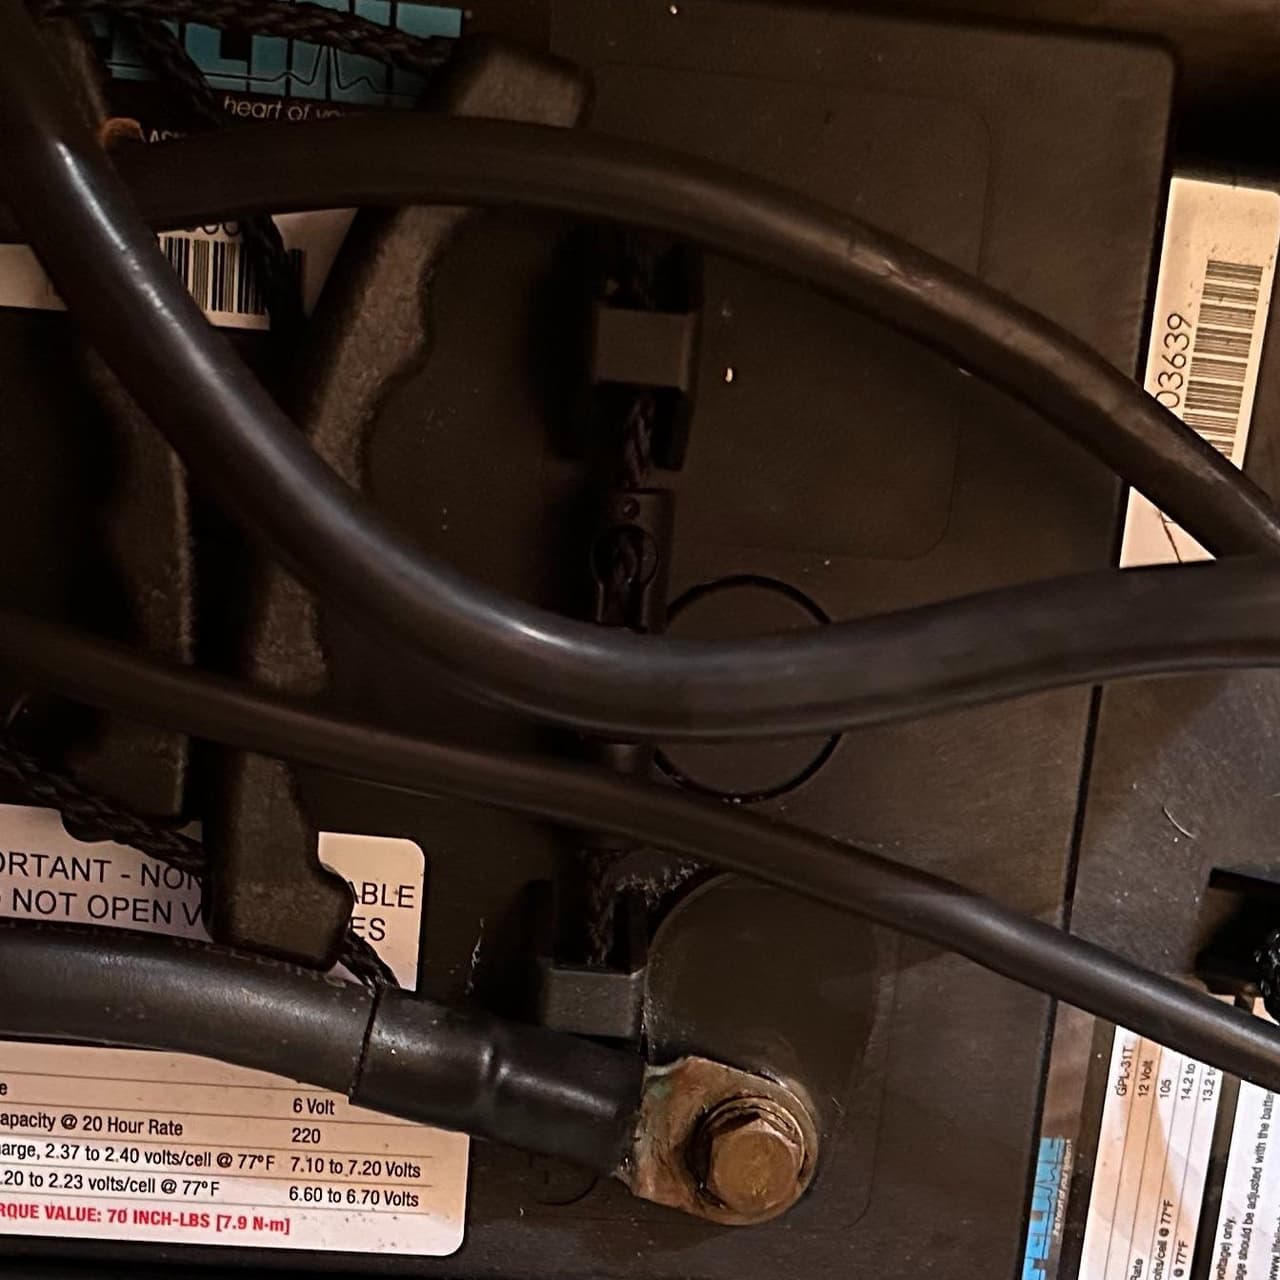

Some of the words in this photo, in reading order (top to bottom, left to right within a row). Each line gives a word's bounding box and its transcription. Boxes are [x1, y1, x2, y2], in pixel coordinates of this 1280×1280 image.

[224, 96, 283, 120] heart
[286, 101, 310, 120] of
[13, 887, 76, 916] NOT
[86, 893, 172, 925] OPEN
[1139, 1058, 1153, 1081] Volt
[1184, 1062, 1195, 1075] to
[1137, 1084, 1149, 1097] 12
[1158, 1078, 1171, 1099] 105
[1180, 1077, 1193, 1100] 14.2
[1201, 1078, 1214, 1102] 13.2
[292, 1098, 302, 1113] 6
[306, 1098, 335, 1115] Volt
[60, 1113, 77, 1130] @
[82, 1114, 102, 1131] 20
[107, 1116, 144, 1134] Hour
[148, 1118, 183, 1136] Rate
[291, 1128, 321, 1143] 220
[1257, 1121, 1269, 1139] the
[45, 1142, 79, 1160] 2.37
[84, 1145, 99, 1161] to
[104, 1146, 138, 1163] 2.40
[144, 1148, 211, 1167] volts/cell
[216, 1153, 233, 1167] @
[1253, 1140, 1266, 1164] with
[290, 1156, 324, 1173] 7.10
[328, 1159, 343, 1174] to
[348, 1160, 381, 1177] 7.20
[384, 1161, 421, 1178] Volts
[28, 1171, 43, 1187] to
[48, 1172, 83, 1189] 2.23
[88, 1175, 155, 1193] volts/cell
[160, 1179, 177, 1194] @
[1245, 1165, 1264, 1209] adjusted
[288, 1185, 323, 1202] 6.60
[326, 1187, 341, 1202] to
[345, 1188, 380, 1205] 6.70
[383, 1190, 419, 1207] Volts
[43, 1205, 102, 1222] VALUE:
[106, 1208, 127, 1224] 70
[133, 1209, 210, 1228] INCH-LBS
[216, 1214, 247, 1233] [7.9
[1221, 1214, 1237, 1239] only.
[1237, 1226, 1252, 1260] should
